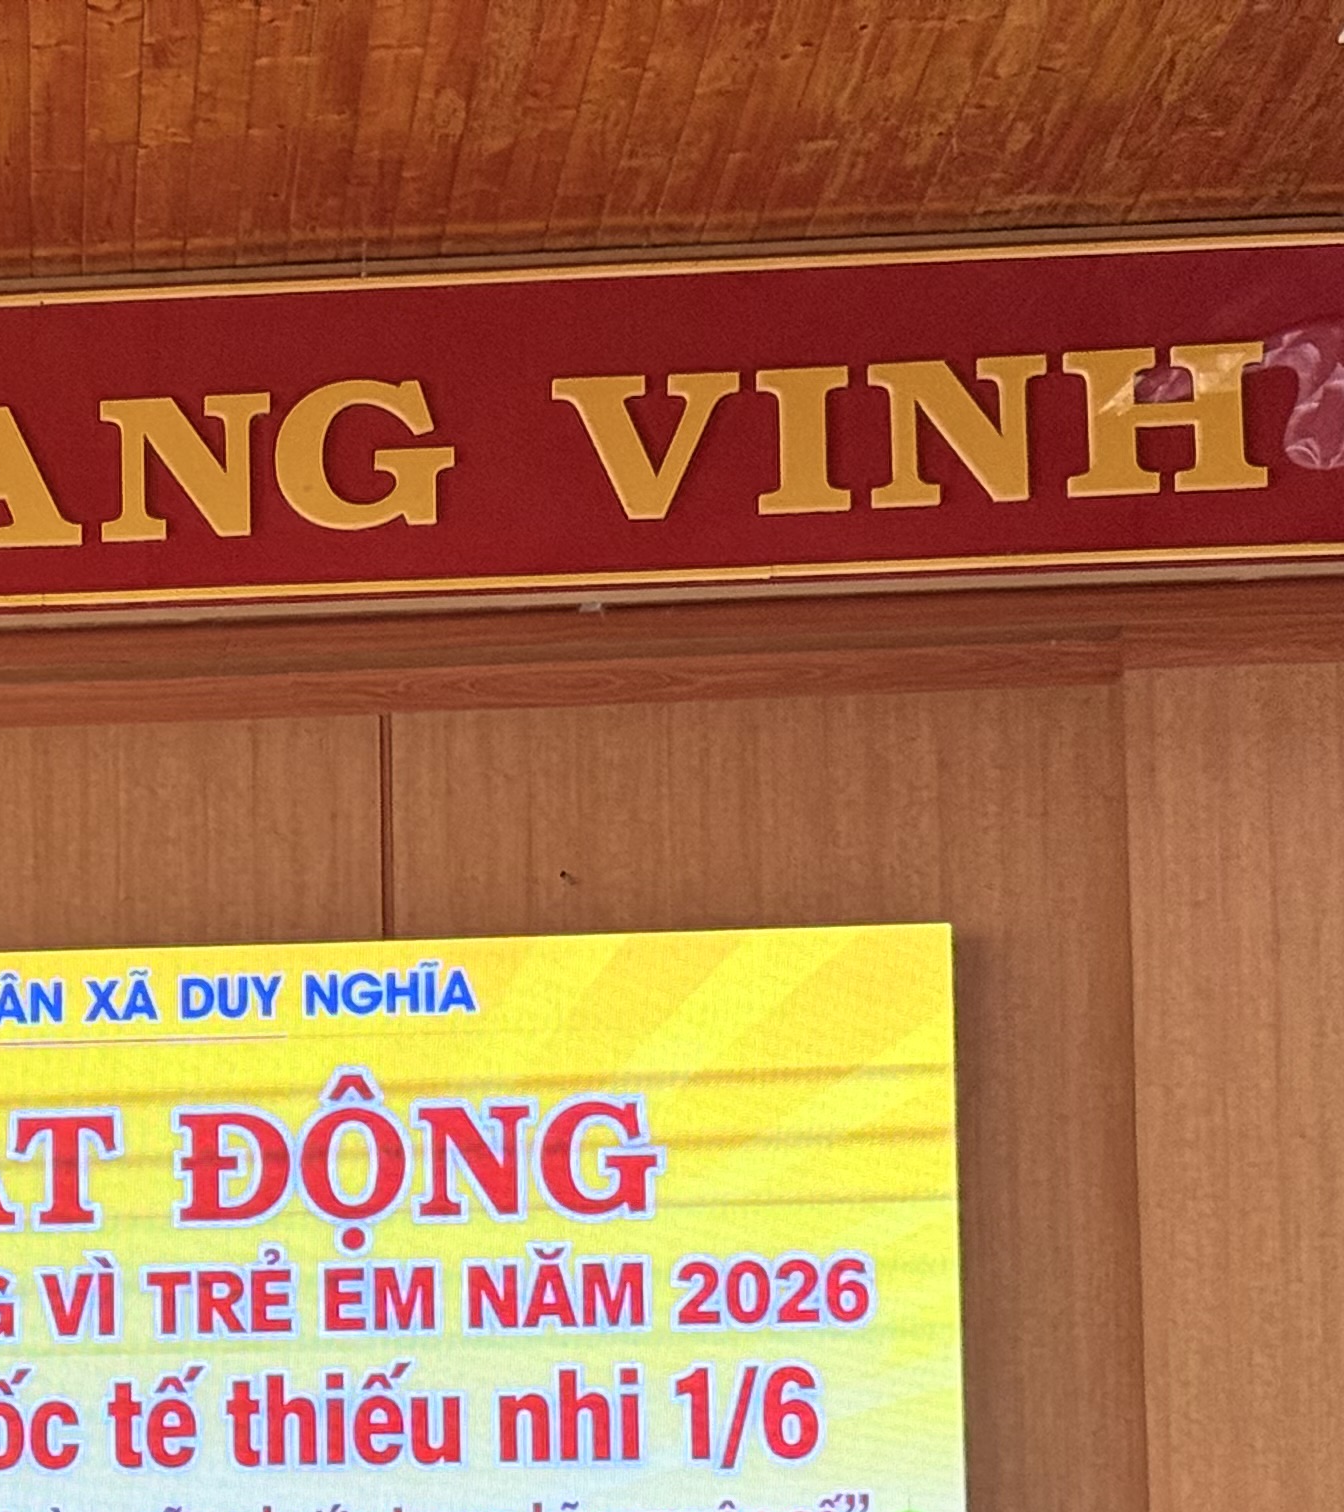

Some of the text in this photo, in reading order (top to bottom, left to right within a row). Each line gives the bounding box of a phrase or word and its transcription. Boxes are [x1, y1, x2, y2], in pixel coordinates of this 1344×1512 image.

[551, 341, 1269, 520] VINH
[85, 970, 158, 1021] XÃ
[181, 976, 282, 1019] DUY
[306, 962, 478, 1016] NGHĨA
[178, 1074, 657, 1250] ĐỘNG
[45, 1256, 113, 1336] VÌ
[147, 1248, 293, 1334] TRẺ
[323, 1266, 436, 1330] EM
[467, 1247, 647, 1327] NĂM
[676, 1258, 870, 1325] 2026
[113, 1365, 208, 1467] tế
[227, 1361, 462, 1466] thiếu
[498, 1367, 640, 1463] nhi
[674, 1364, 820, 1470] 1/6
